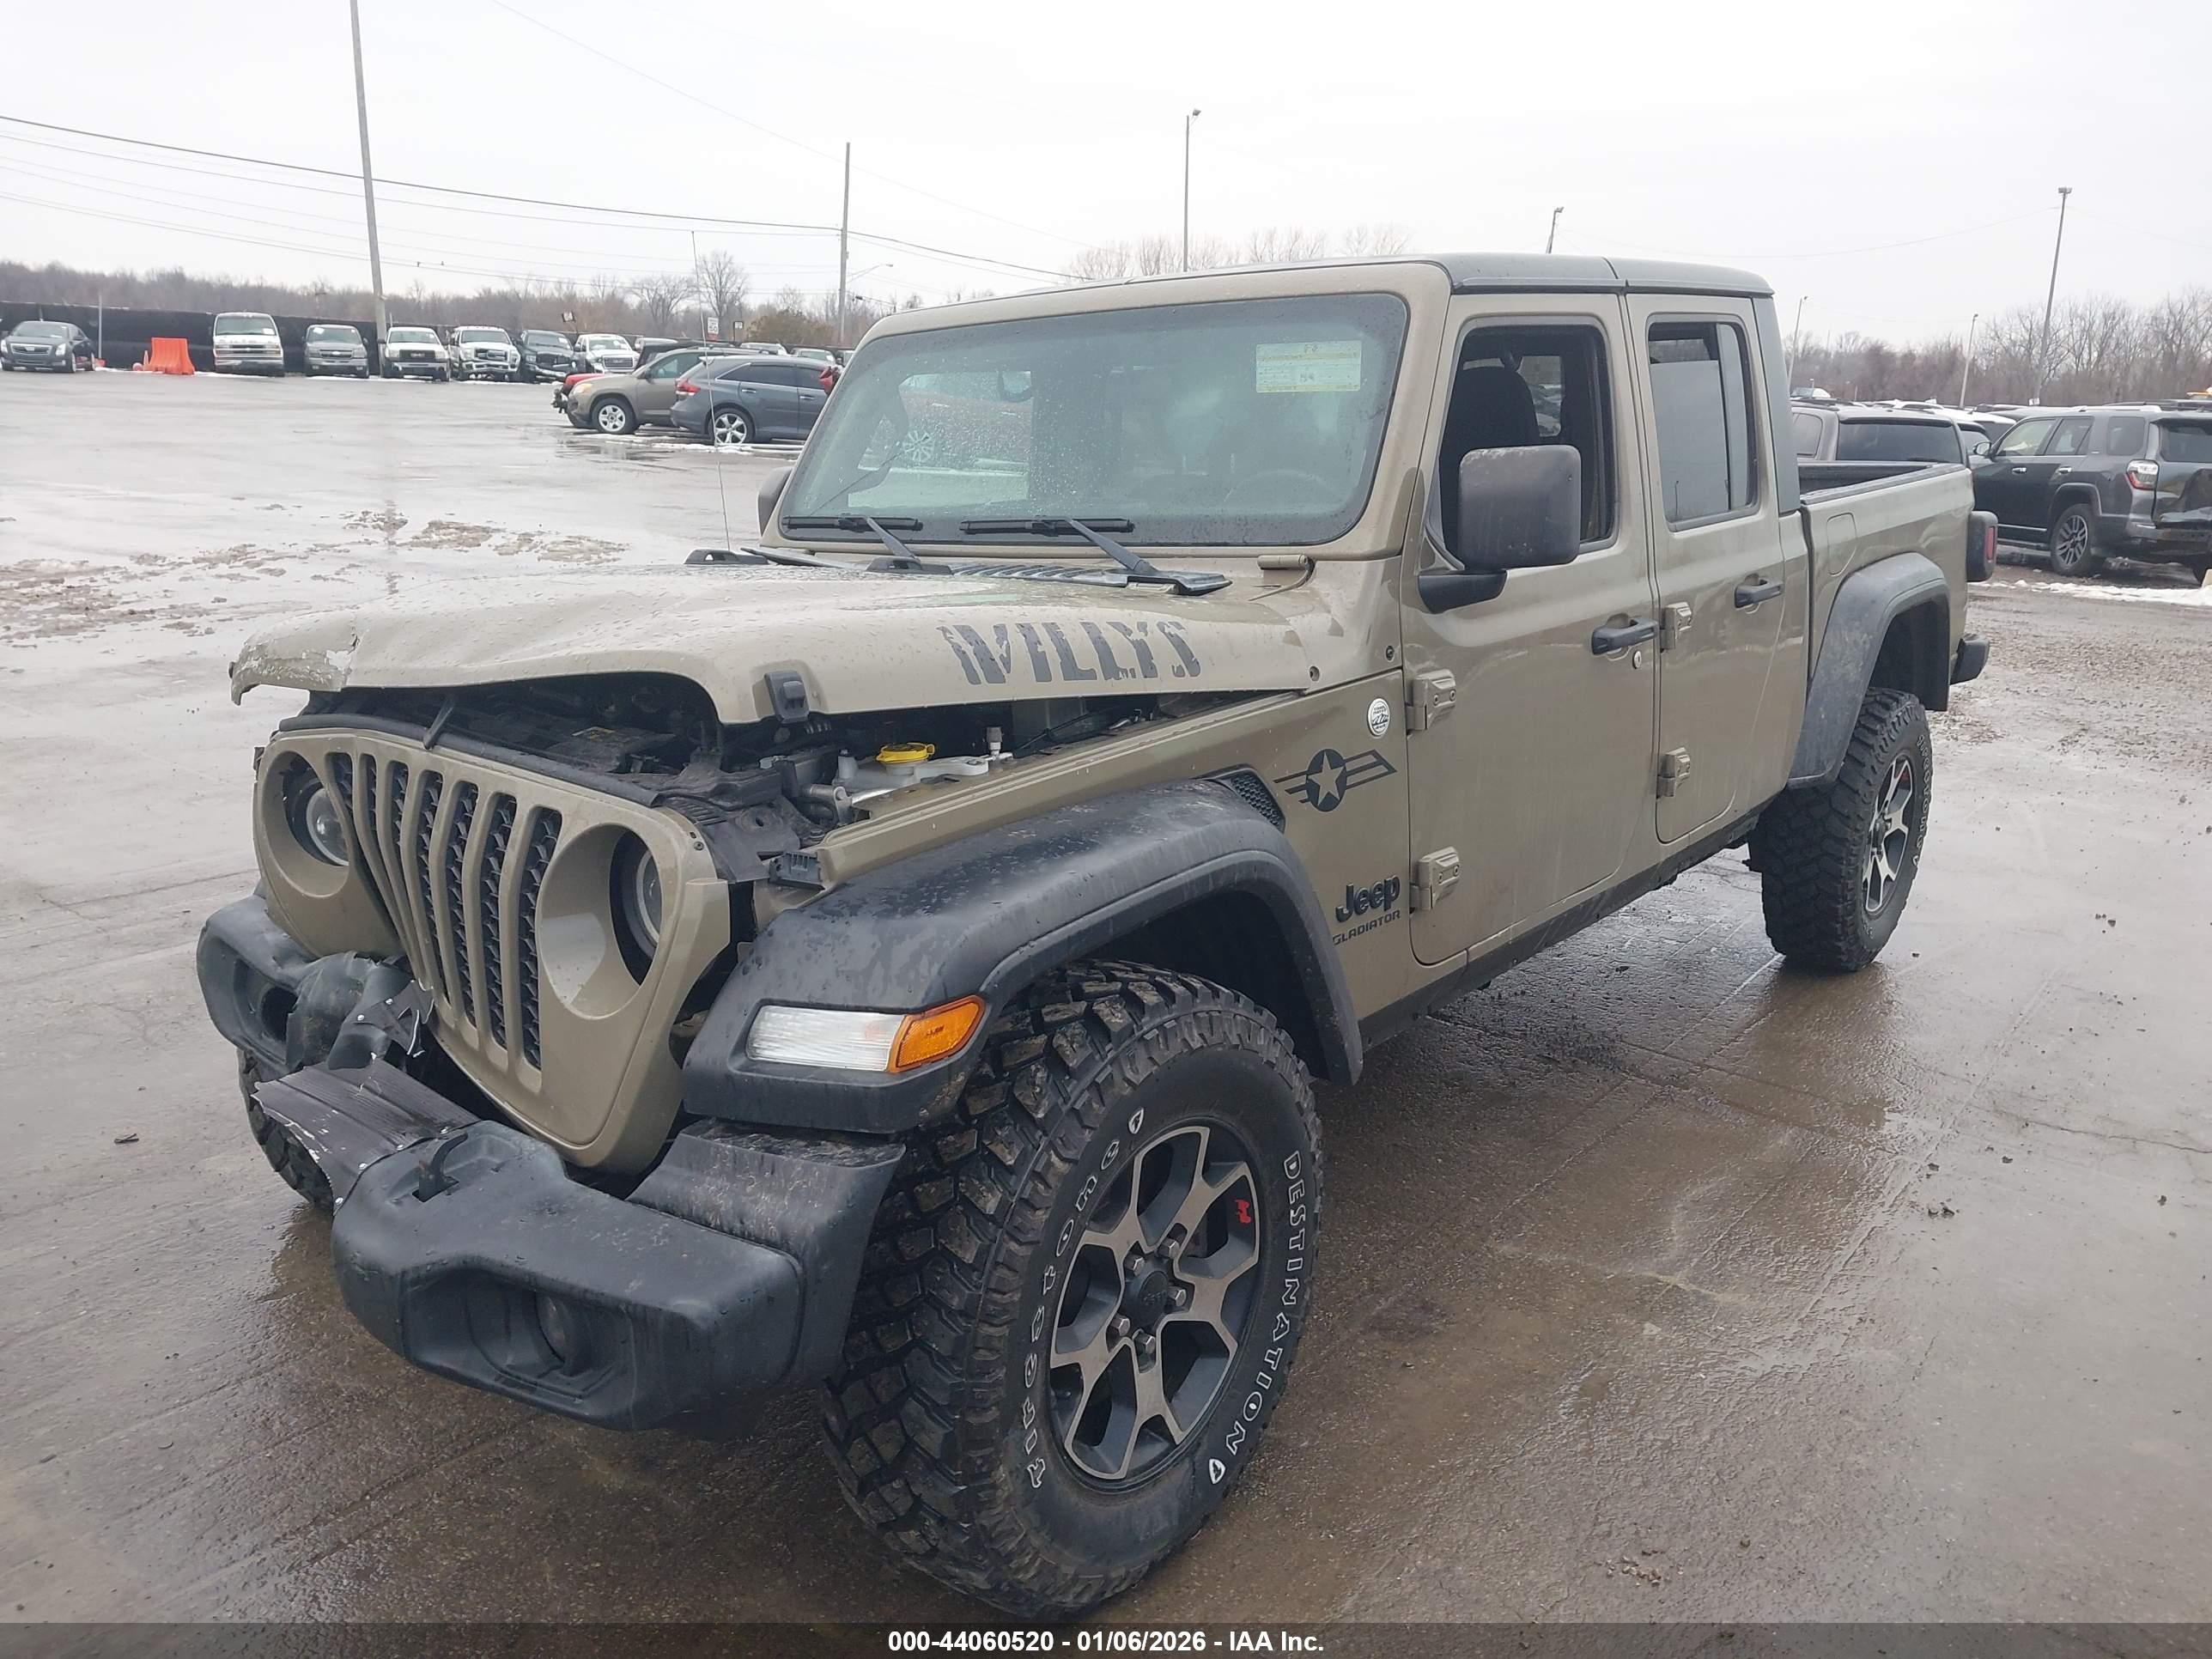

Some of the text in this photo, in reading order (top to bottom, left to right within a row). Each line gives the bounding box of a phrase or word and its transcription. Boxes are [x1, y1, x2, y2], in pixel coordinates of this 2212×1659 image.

[936, 620, 1201, 684] WILLYS
[1332, 909, 1401, 945] GLADIATOR
[1335, 875, 1401, 923] Jeep
[1225, 1150, 1306, 1455] DESTINATION
